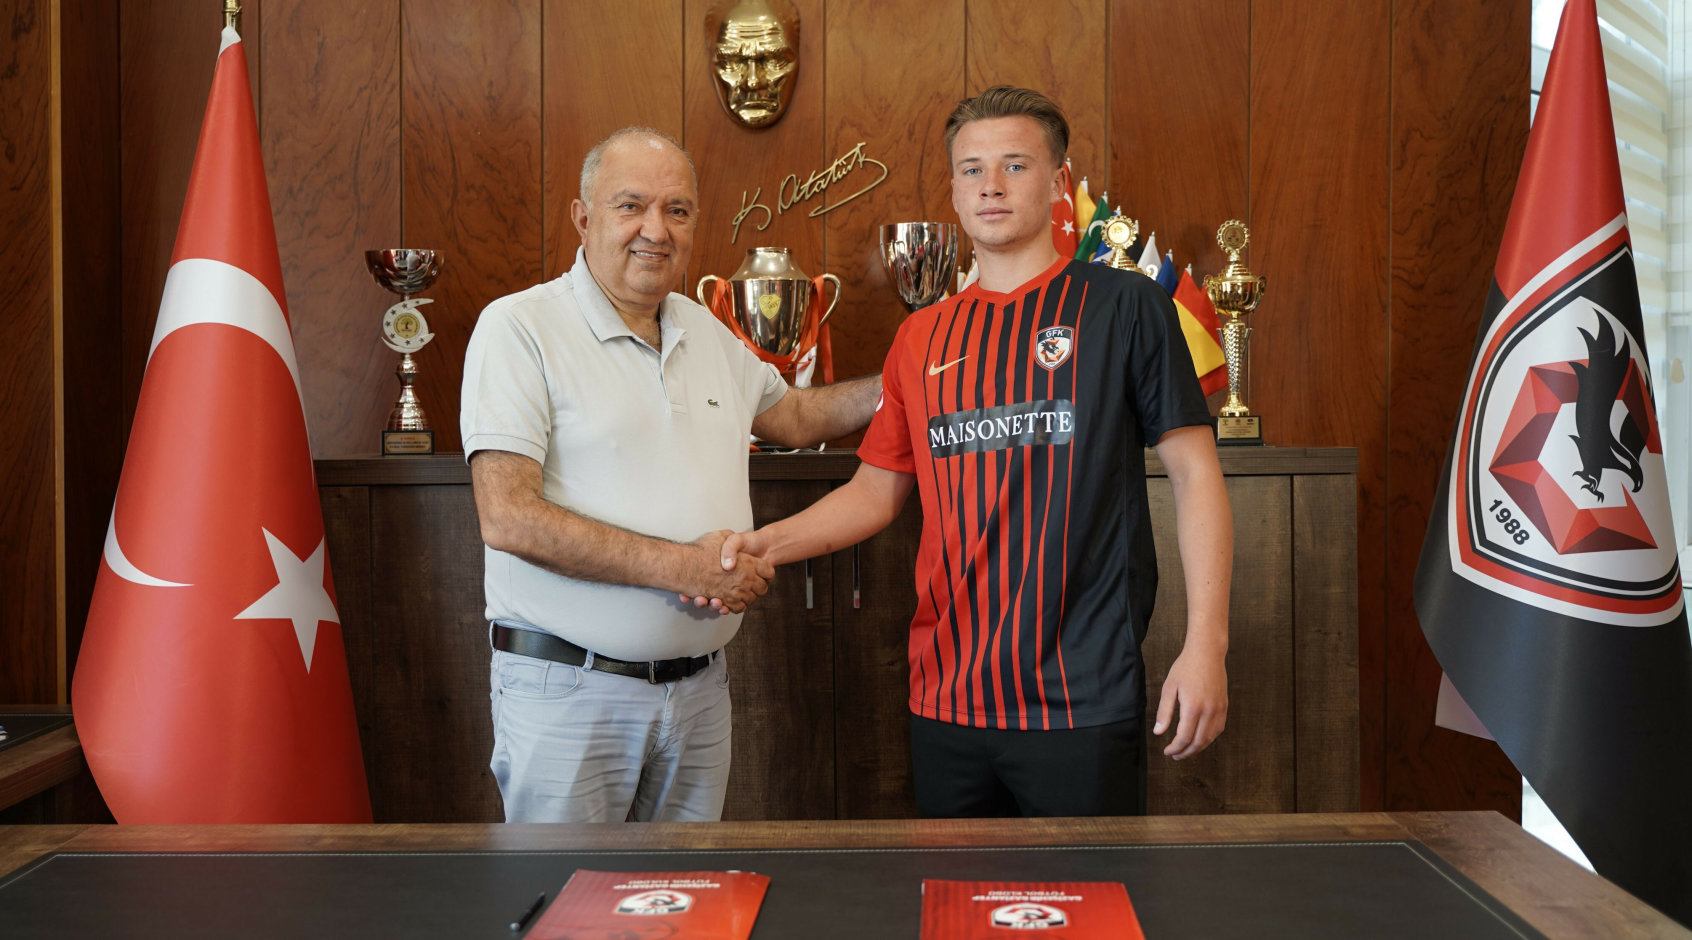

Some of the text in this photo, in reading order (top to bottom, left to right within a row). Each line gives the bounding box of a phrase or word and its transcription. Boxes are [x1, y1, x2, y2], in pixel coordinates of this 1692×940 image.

[1046, 329, 1064, 337] GFK
[929, 411, 1072, 448] MAISONETTE
[1489, 499, 1530, 545] 1988
